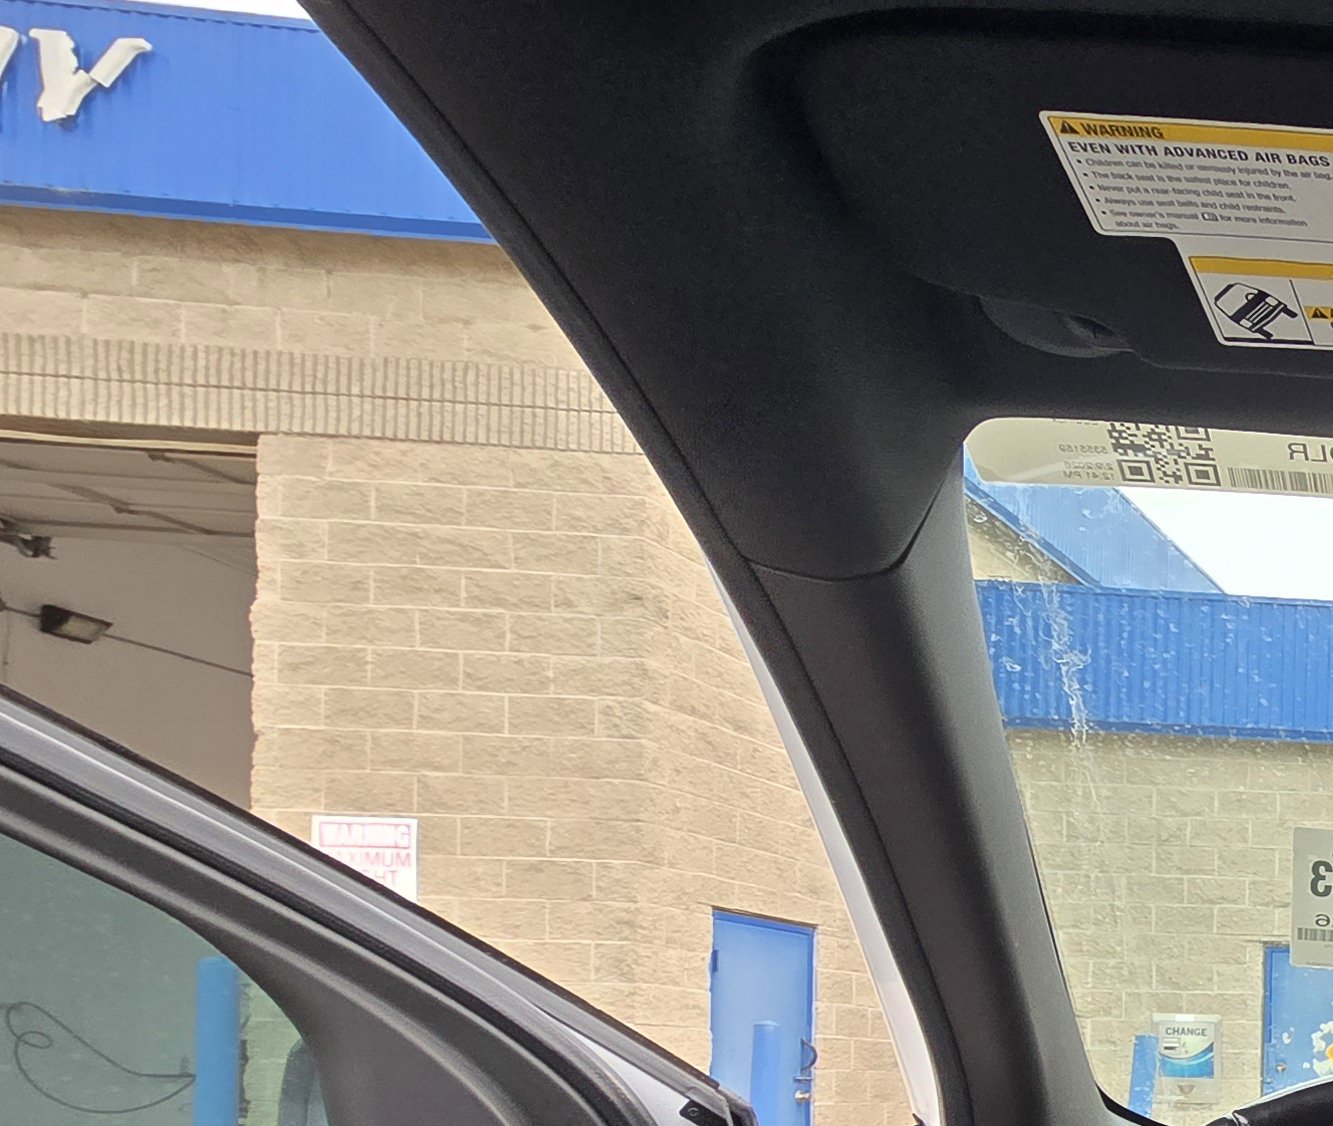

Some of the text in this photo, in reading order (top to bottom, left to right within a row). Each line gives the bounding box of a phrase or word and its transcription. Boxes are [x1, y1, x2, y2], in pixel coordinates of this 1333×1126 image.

[1080, 122, 1164, 139] WARNING
[1068, 141, 1330, 167] EVEN WITH ADVANCED AIR BAGS
[1165, 1027, 1207, 1036] CHANGE
